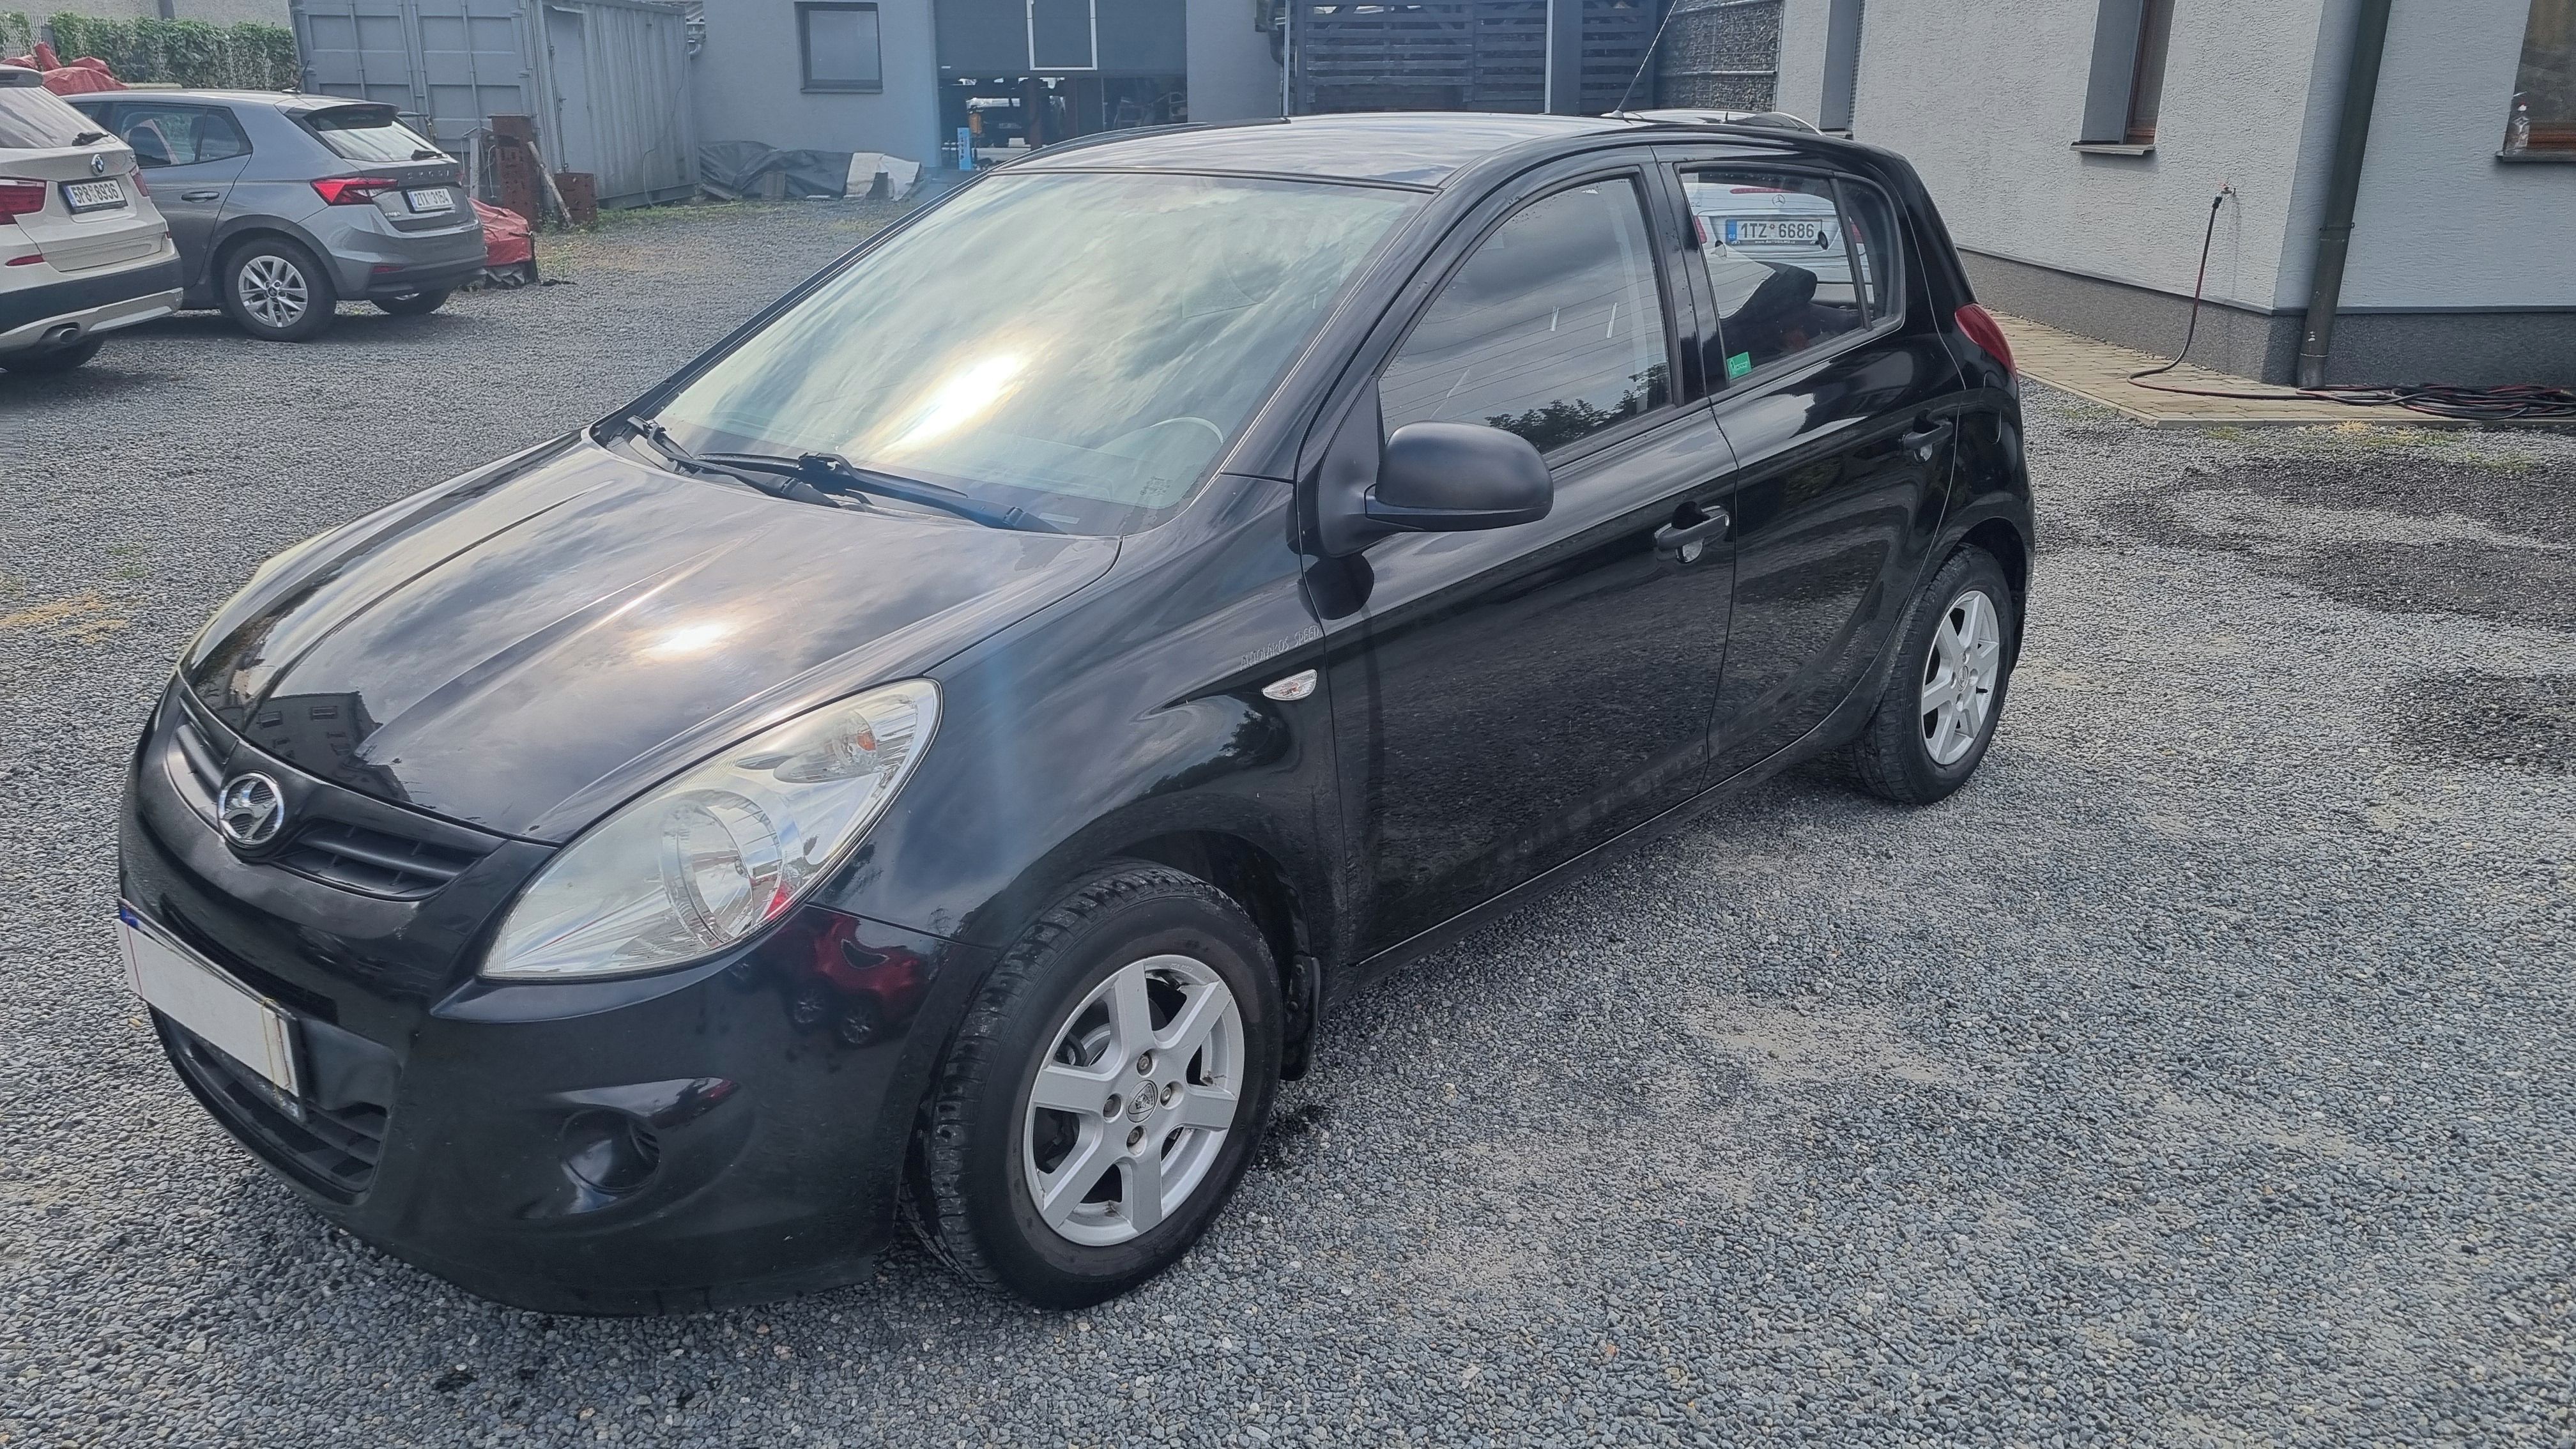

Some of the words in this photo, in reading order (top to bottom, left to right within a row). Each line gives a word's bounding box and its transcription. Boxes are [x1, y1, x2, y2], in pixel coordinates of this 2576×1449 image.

[71, 186, 93, 203] 5P8
[93, 183, 118, 201] 8936
[414, 192, 430, 206] 2TX
[1741, 223, 1767, 238] 1TZ
[1779, 223, 1814, 238] 6686
[1294, 625, 1319, 647] SPEED
